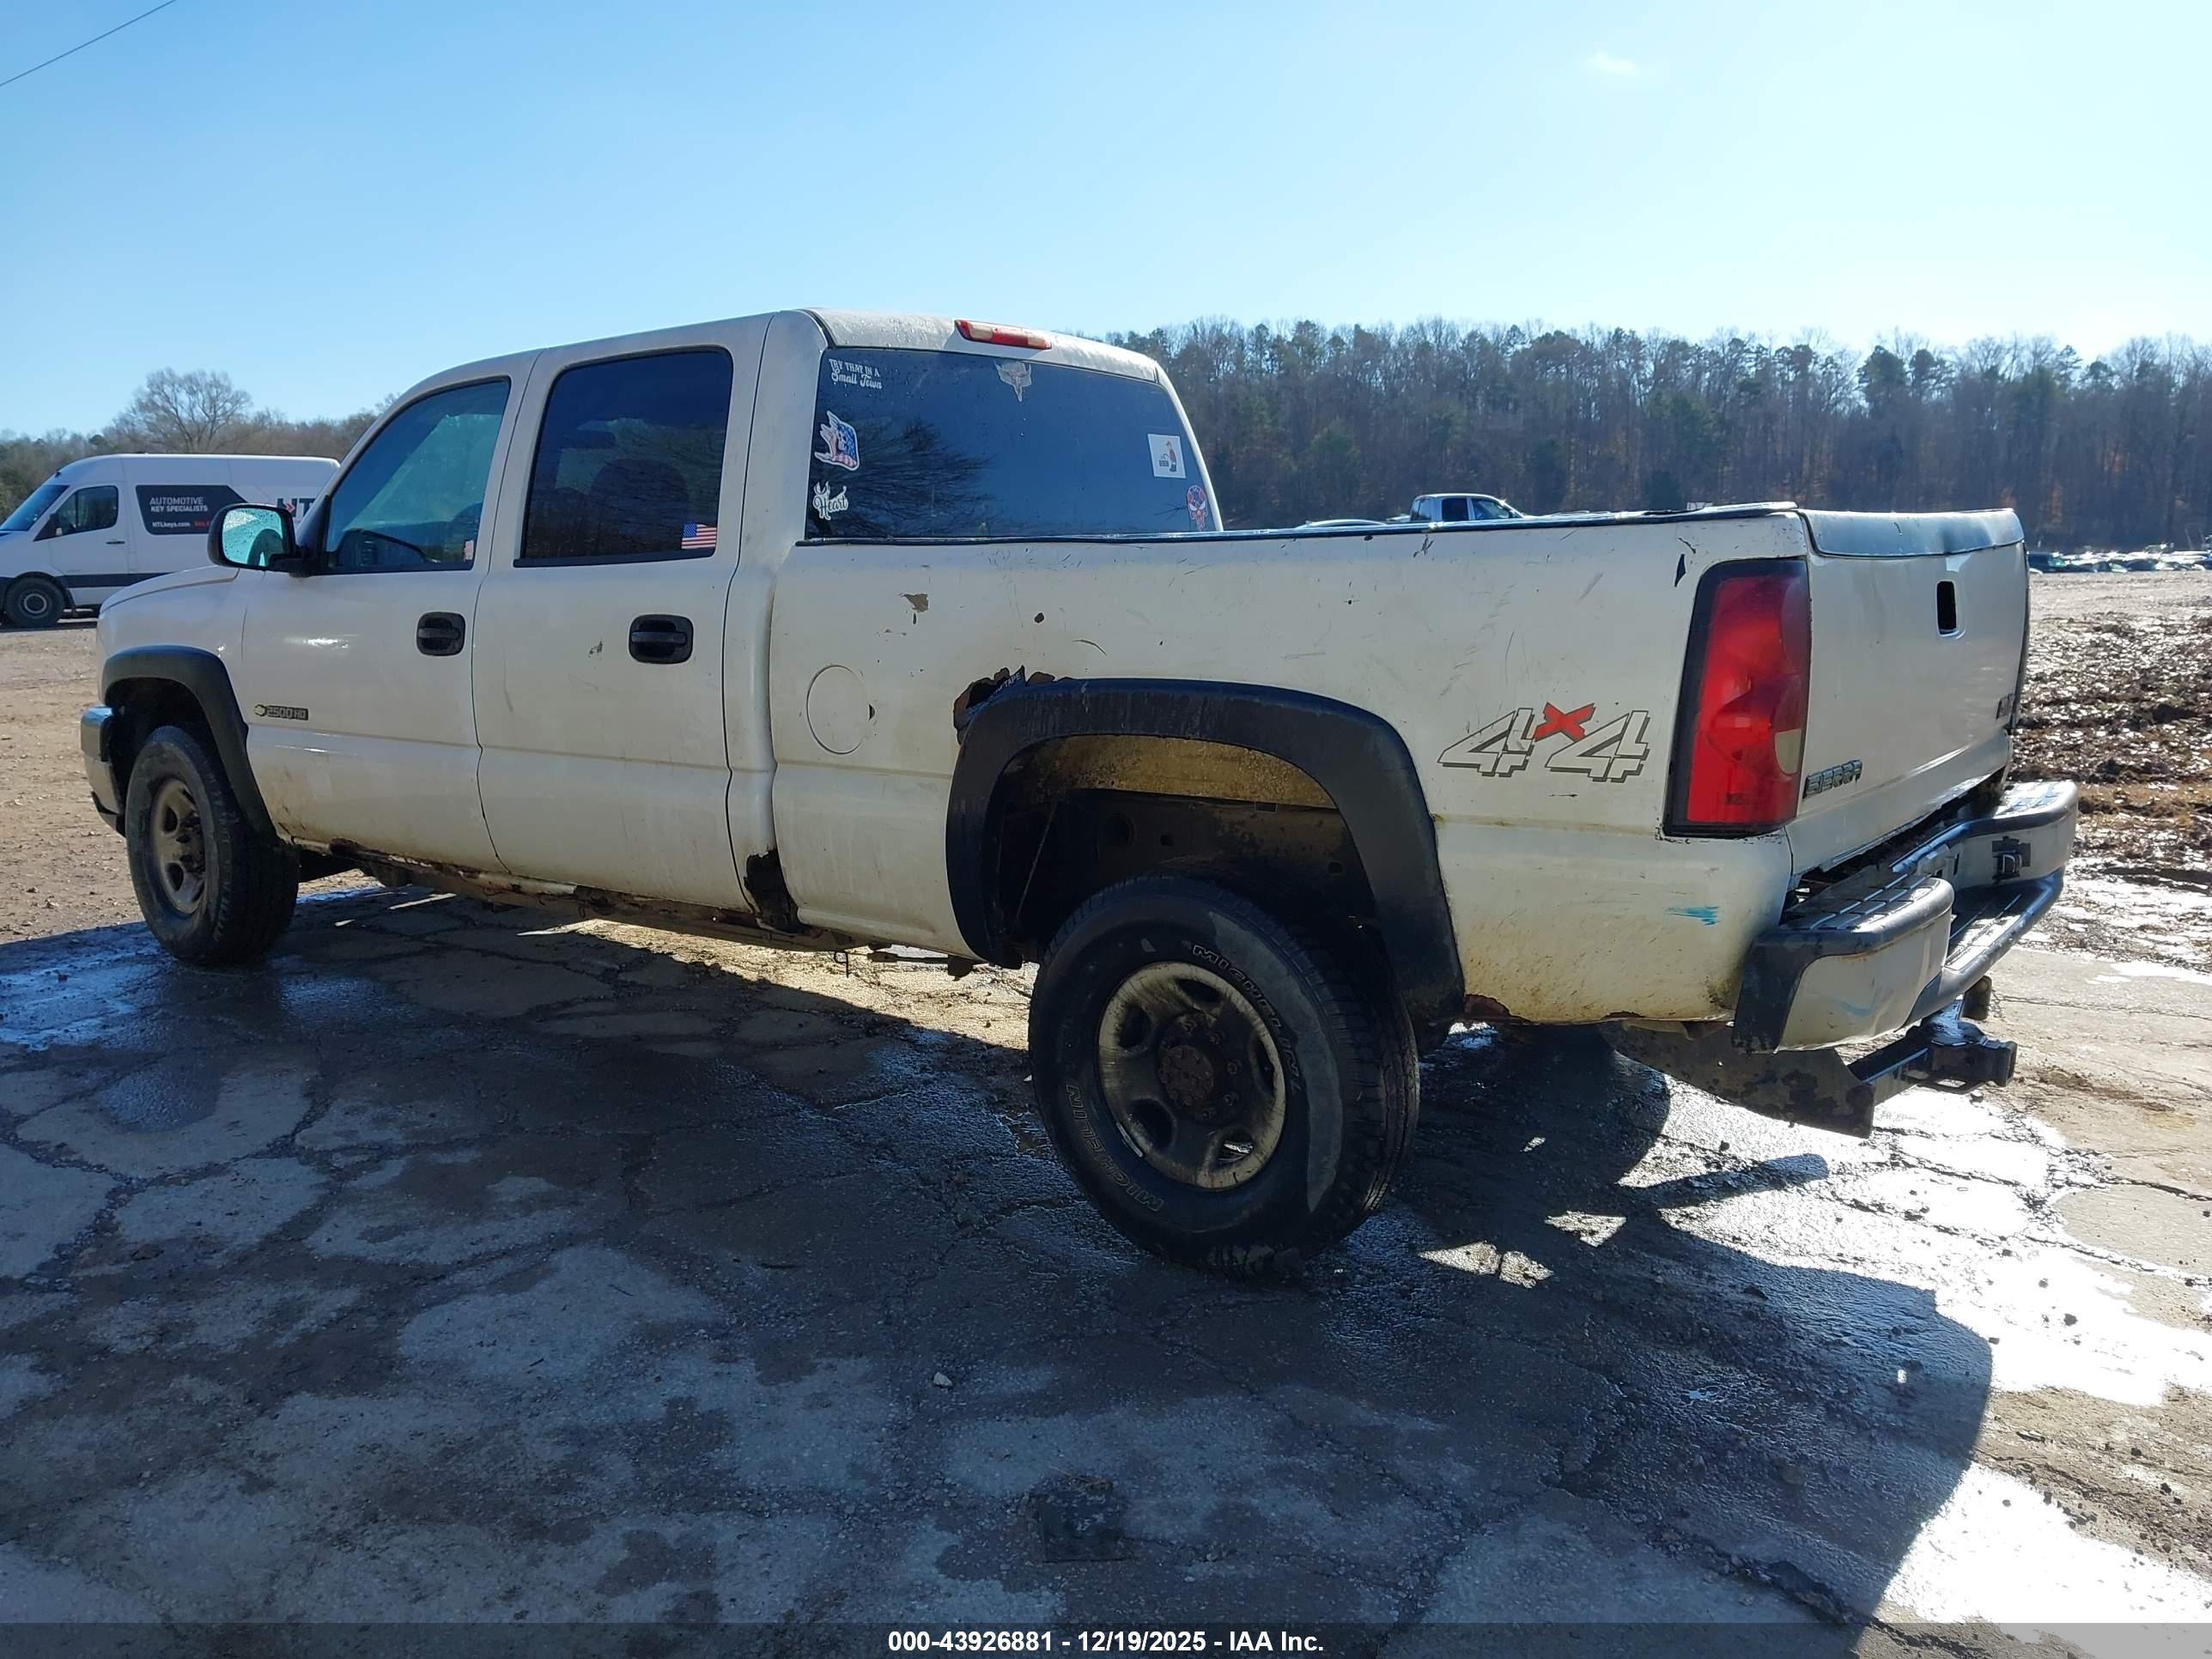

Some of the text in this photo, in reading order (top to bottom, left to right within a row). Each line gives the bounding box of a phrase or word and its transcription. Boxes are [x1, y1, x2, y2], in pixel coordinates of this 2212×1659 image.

[829, 359, 843, 372] TRY
[845, 362, 864, 374] THAT
[874, 368, 880, 378] A
[831, 368, 883, 390] Small Town
[1065, 1085, 1165, 1212] MICHELIN
